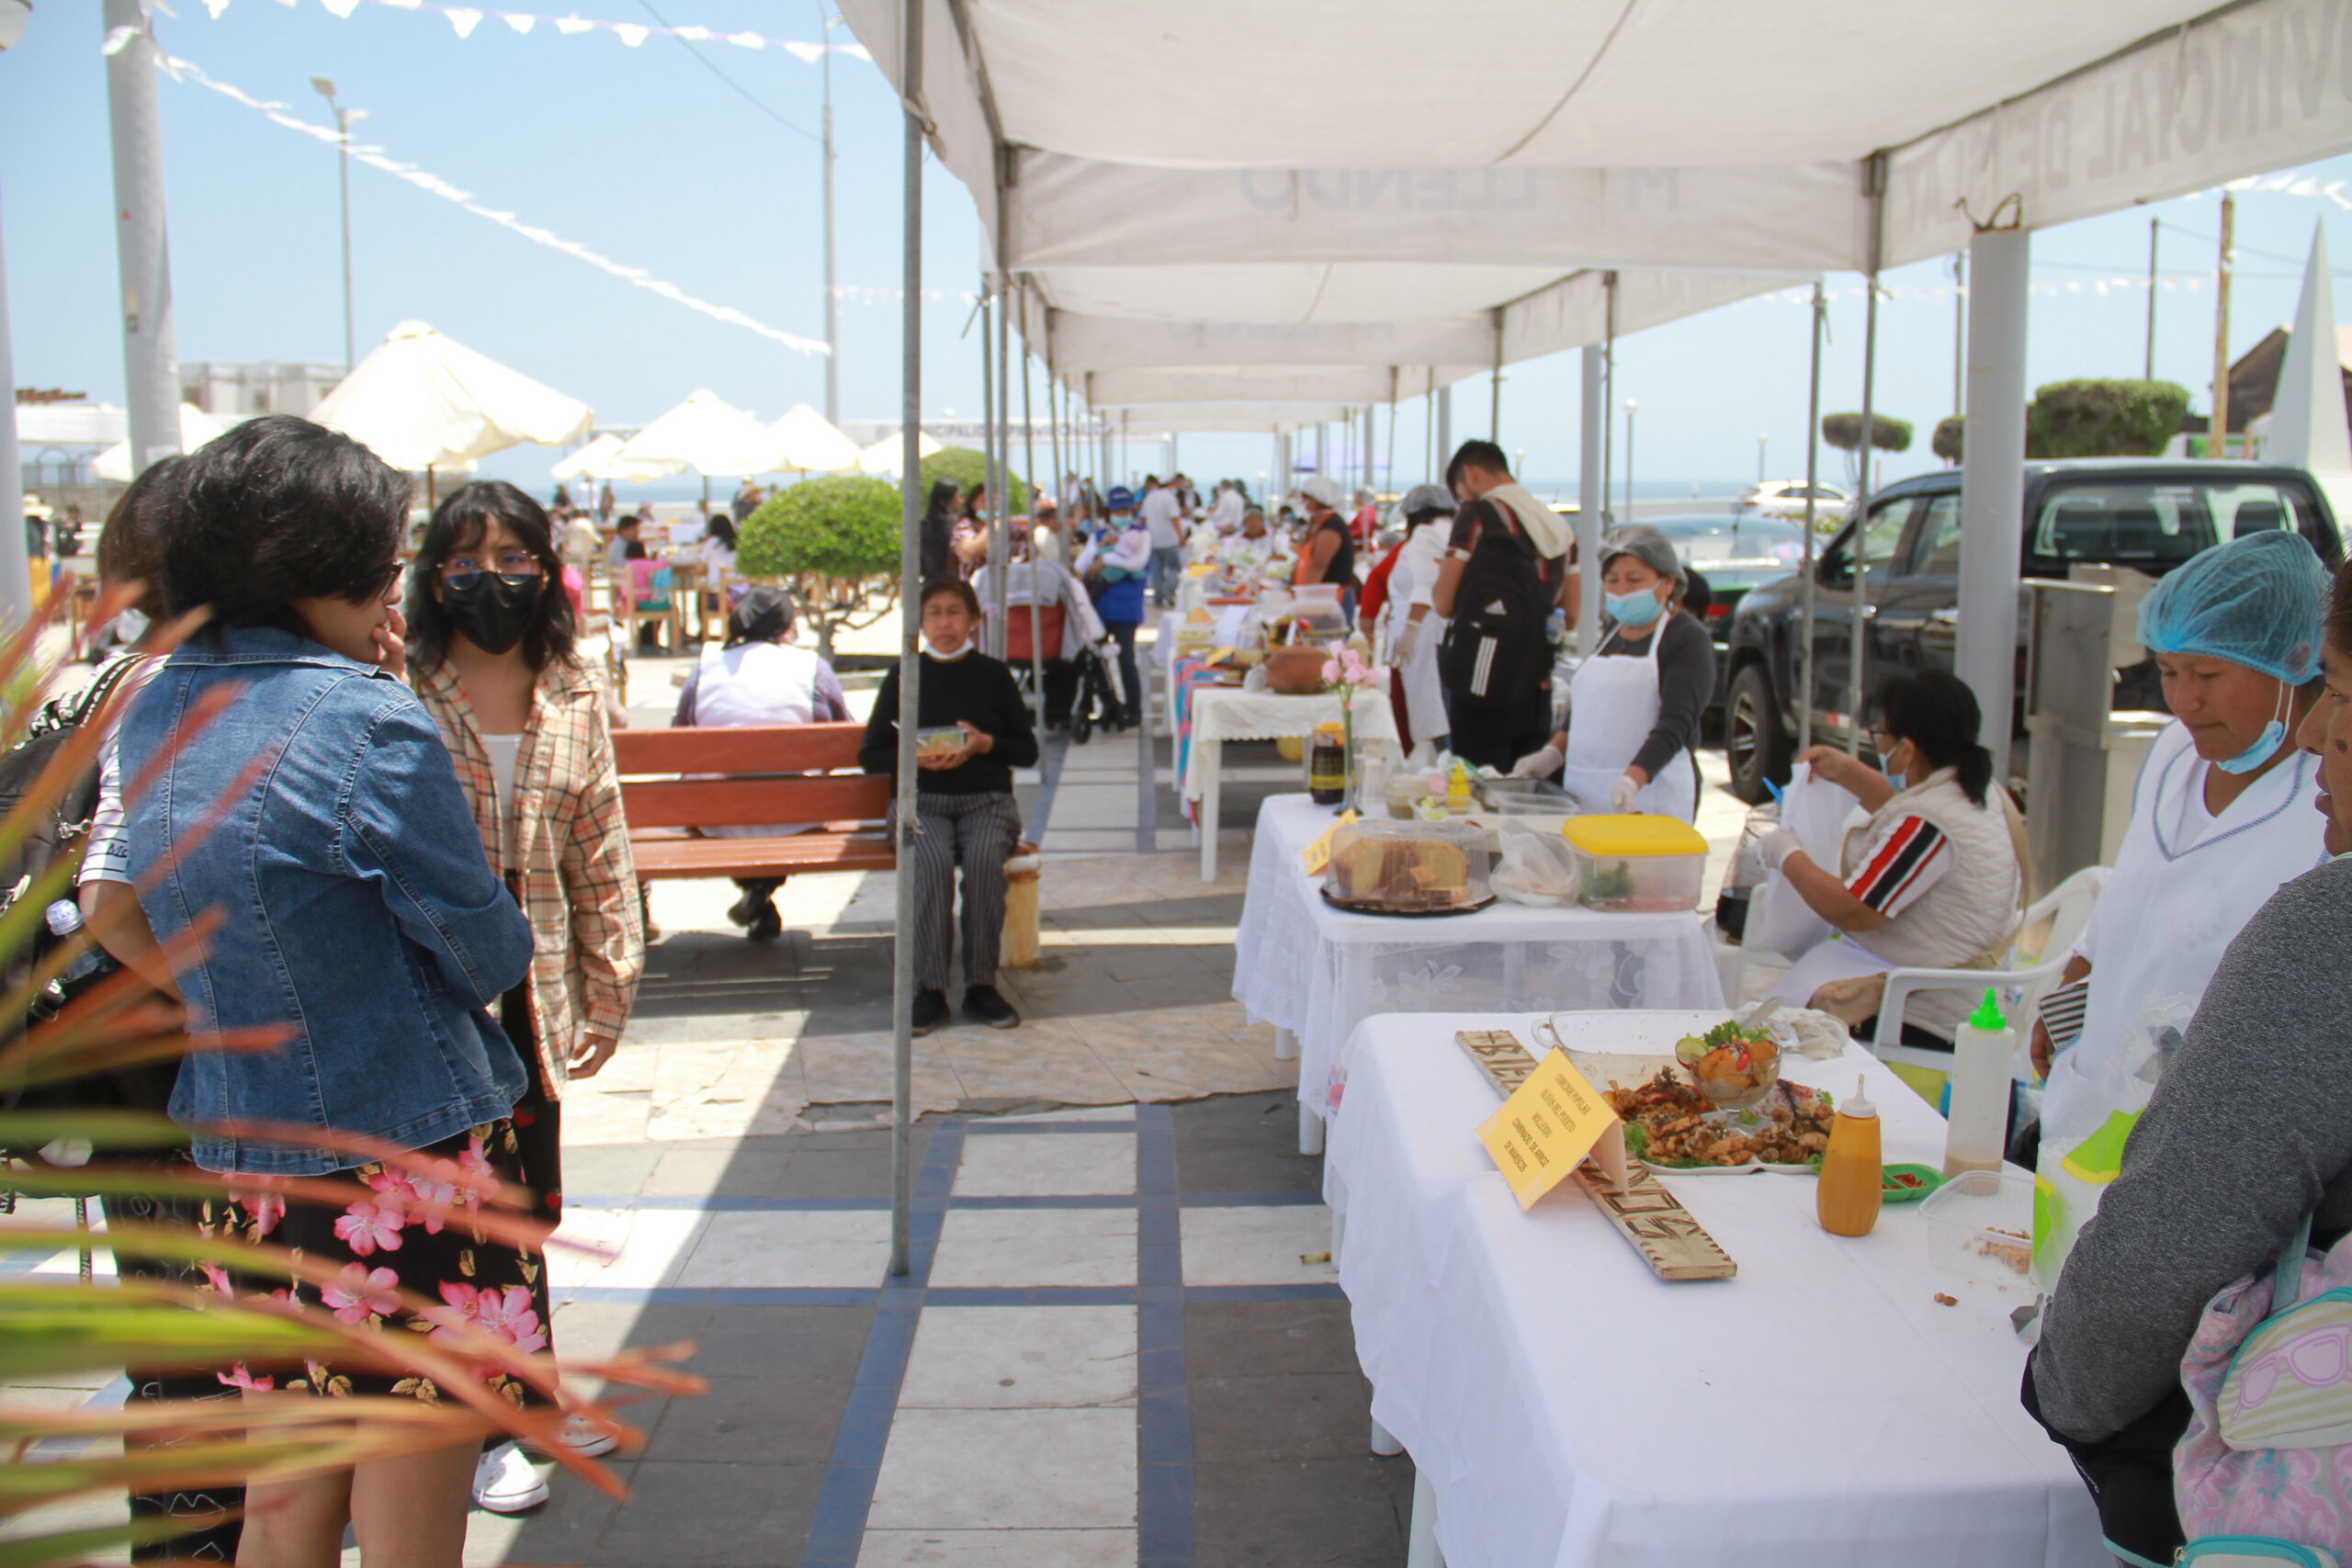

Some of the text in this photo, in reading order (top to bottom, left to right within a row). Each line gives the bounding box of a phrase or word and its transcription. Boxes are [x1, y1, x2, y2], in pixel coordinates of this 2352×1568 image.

[1503, 1140, 1527, 1173] DE MARISCOS
[1512, 1117, 1550, 1168] COMBINADO DE ARROZ
